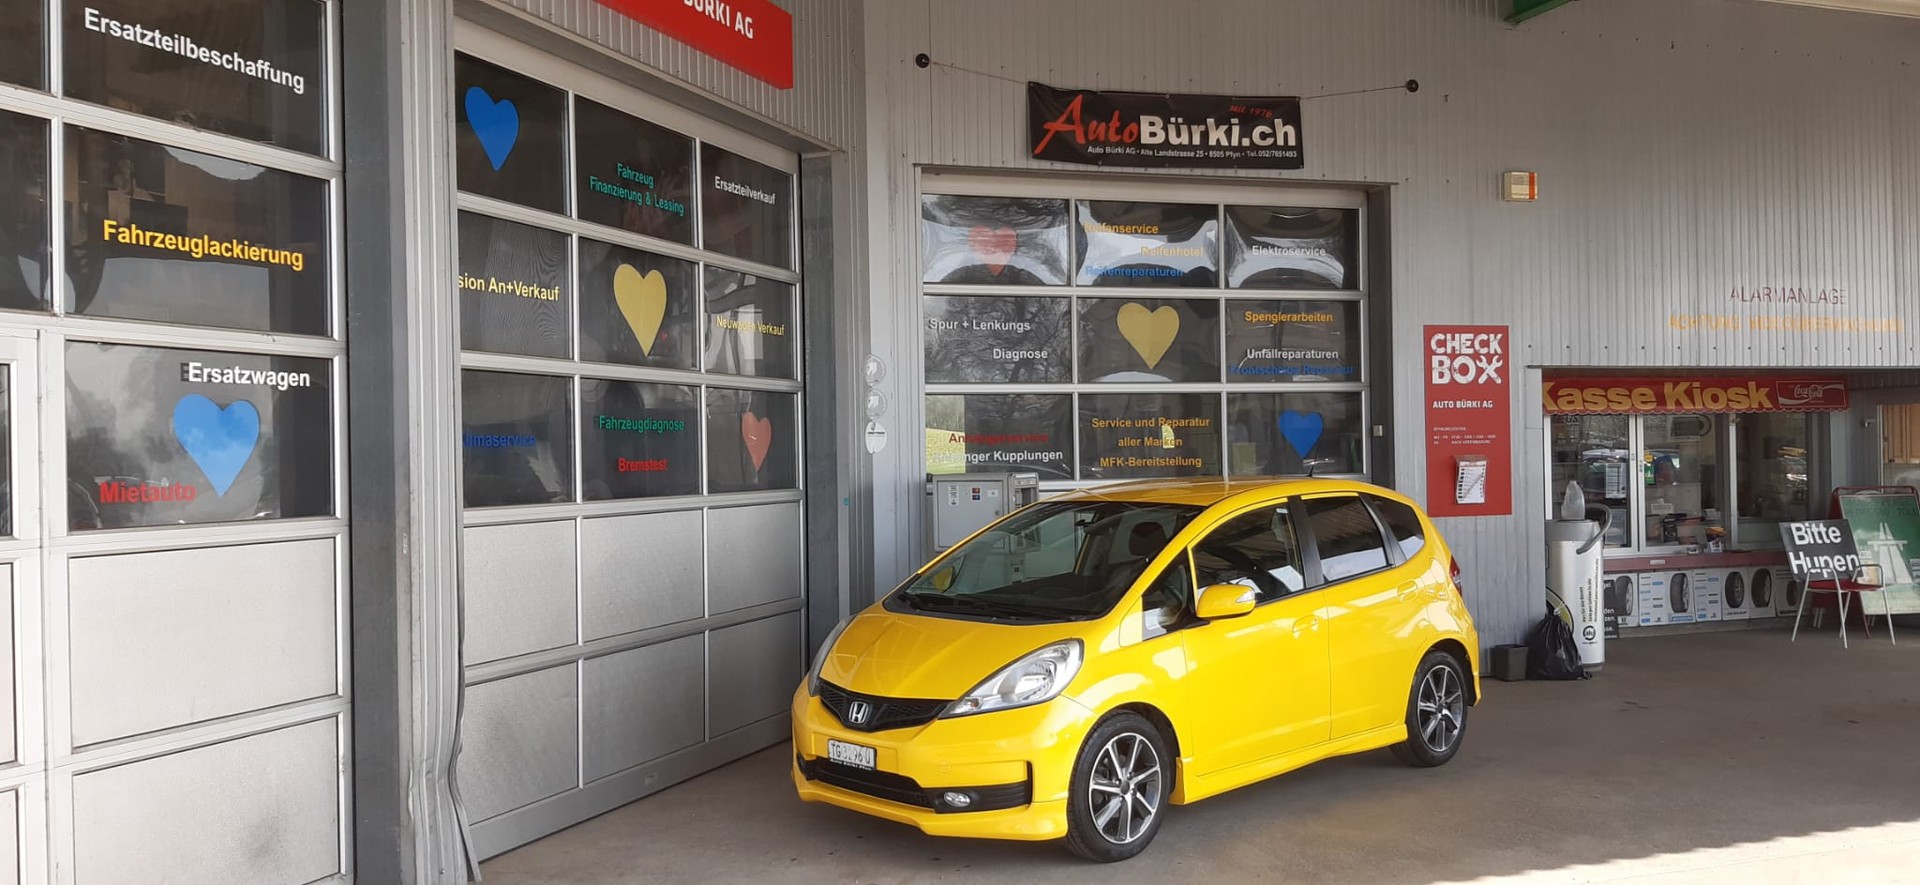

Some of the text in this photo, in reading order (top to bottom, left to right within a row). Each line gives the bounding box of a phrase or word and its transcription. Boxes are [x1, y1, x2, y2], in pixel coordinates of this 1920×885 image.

[735, 12, 753, 39] AG
[84, 7, 304, 94] Ersatzteilbeschaffung
[1087, 146, 1104, 154] Auto
[1106, 146, 1124, 155] Bürki
[1126, 147, 1136, 156] AG
[1154, 150, 1194, 158] Landstrasse
[617, 163, 654, 189] Fahrzeug
[589, 176, 685, 217] Finanzierung & Leasing
[714, 176, 776, 205] Ersatzteilverkauf
[103, 219, 304, 271] Fahrzeuglackierung
[1251, 245, 1326, 257] Elektroservice
[488, 276, 560, 300] An+Verkauf
[1730, 286, 1847, 305] ALARMANLAGE
[929, 318, 958, 332] Spur
[972, 319, 1031, 332] Lenkungs
[1244, 311, 1334, 324] Spenglerarbeiten
[757, 321, 785, 336] Verkauf
[1430, 333, 1503, 354] CHECK
[993, 348, 1048, 361] Diagnose
[188, 361, 311, 390] Ersatzwagen
[1433, 399, 1493, 409] AUTO BÜRKI AG
[1542, 382, 1657, 411] Kasse
[1664, 382, 1773, 409] Kiosk
[599, 415, 685, 433] Fahrzeugdiagnose
[1091, 416, 1210, 430] Service und Reparatur
[464, 433, 536, 448] limaservice
[1118, 436, 1141, 447] aller
[617, 457, 669, 472] Bremstest
[993, 451, 1063, 463] Kupplungen
[1100, 456, 1202, 469] MFK-Bereitstellung
[100, 481, 197, 504] Mietauto
[1790, 522, 1842, 545] Bitte
[1788, 551, 1860, 578] Hupen
[831, 742, 841, 758] TG
